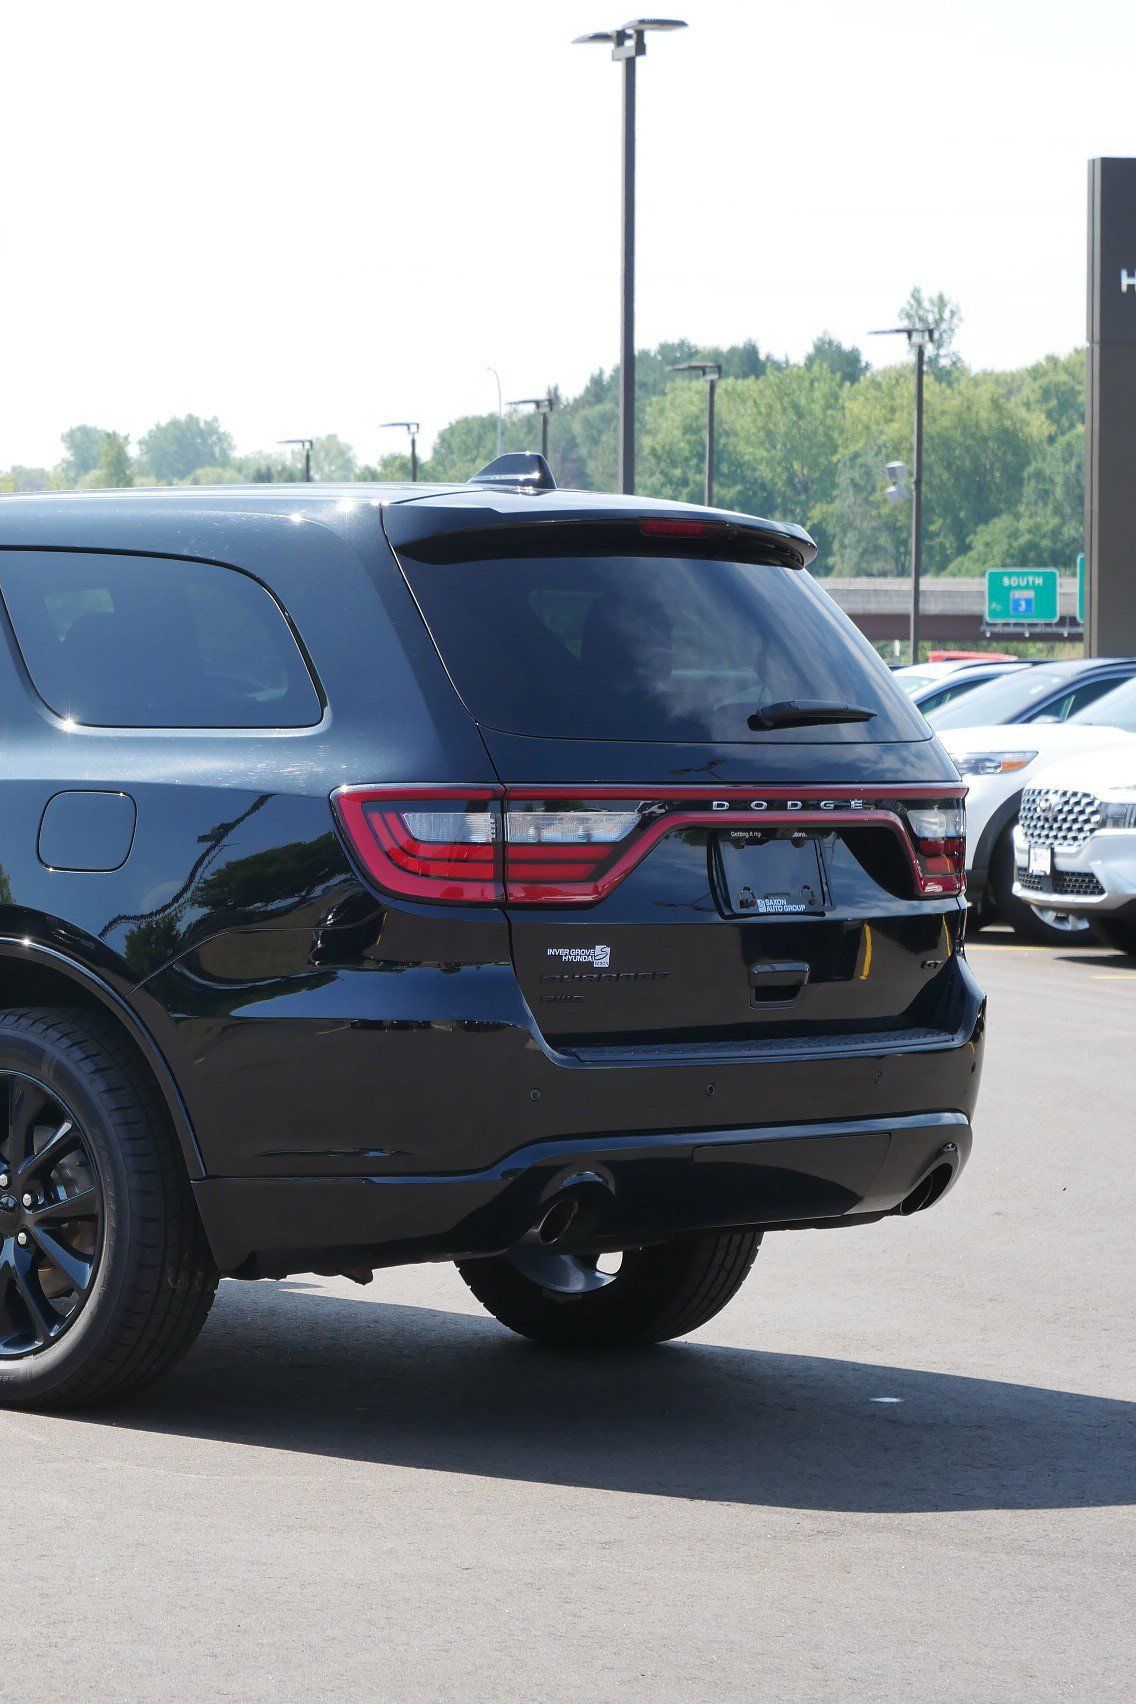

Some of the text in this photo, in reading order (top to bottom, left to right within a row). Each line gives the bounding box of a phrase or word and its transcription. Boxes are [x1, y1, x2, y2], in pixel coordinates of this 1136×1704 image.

[1002, 575, 1043, 587] SOUTH
[1018, 601, 1026, 612] 3
[712, 799, 863, 810] DODGE
[784, 904, 806, 912] GROUP
[547, 948, 569, 956] INVER
